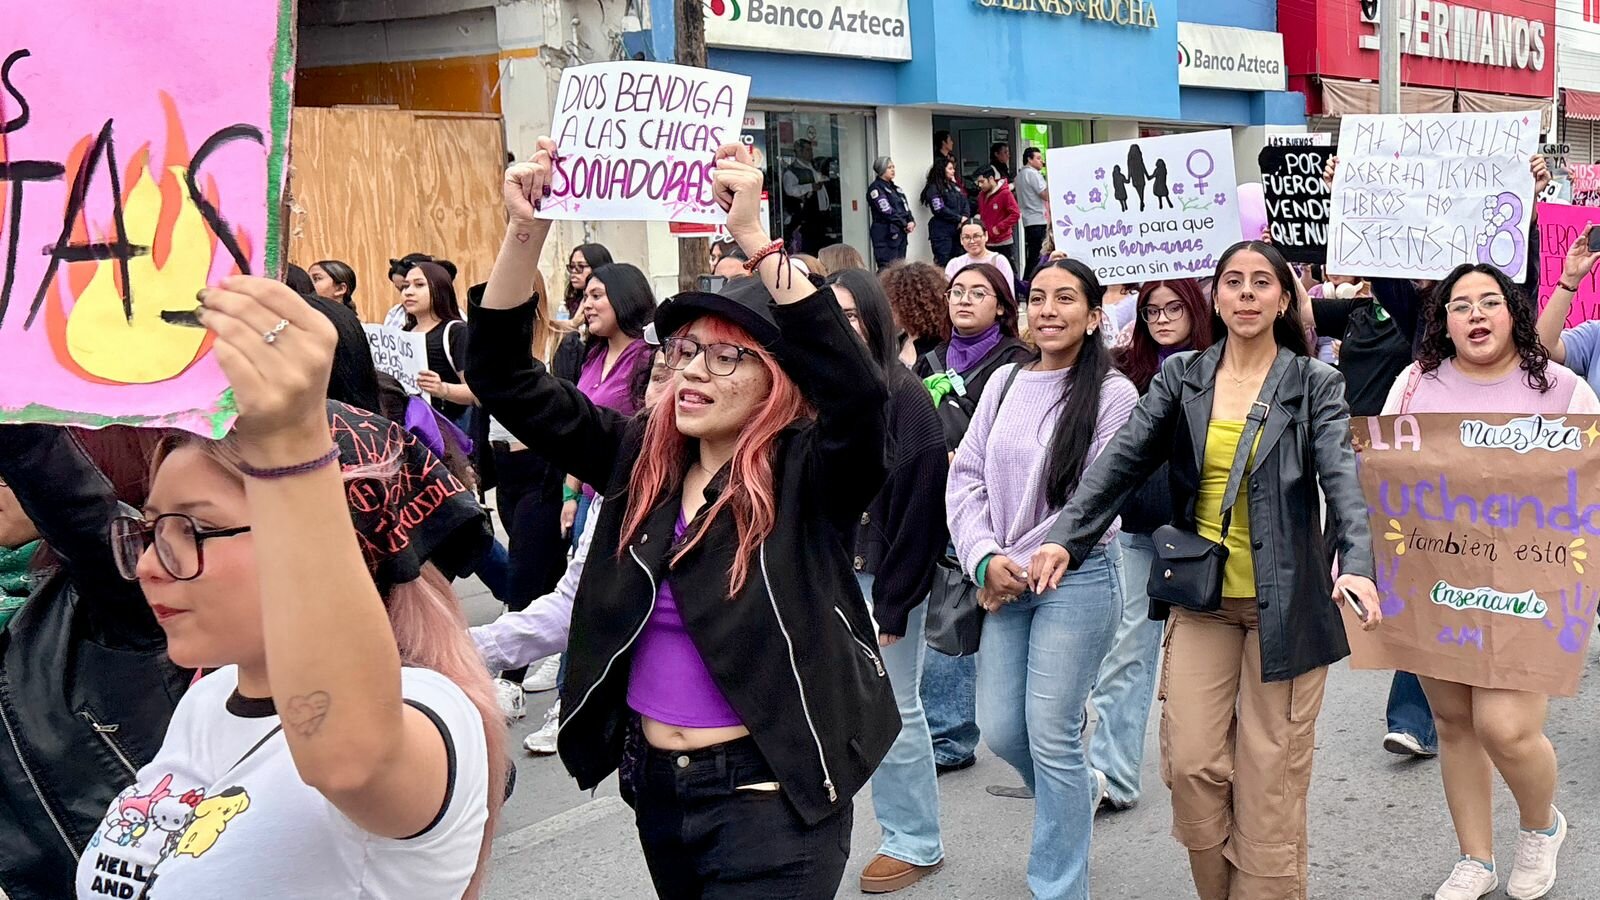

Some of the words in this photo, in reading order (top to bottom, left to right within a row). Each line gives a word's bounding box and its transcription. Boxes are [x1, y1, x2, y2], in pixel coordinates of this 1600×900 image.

[747, 0, 823, 30] Banco
[828, 6, 905, 37] Azteca
[1088, 0, 1160, 28] ROCHA
[1194, 49, 1235, 71] Banco
[1237, 53, 1279, 74] Azteca
[562, 73, 608, 113] DIOS
[615, 72, 734, 119] BENDIGA
[558, 115, 579, 148] A
[585, 116, 627, 149] LAS
[639, 119, 725, 154] CHICAS
[1400, 119, 1521, 157] MOCHILA
[1543, 144, 1570, 154] GRITO
[1285, 152, 1323, 175] POR
[553, 154, 716, 207] SOÑADORAS
[1342, 191, 1407, 216] LIBROS
[1139, 221, 1178, 237] para
[1182, 216, 1214, 233] que
[1092, 245, 1117, 258] mis
[1119, 238, 1204, 257] hermanas
[1340, 222, 1469, 266] DEFENSA
[1093, 264, 1146, 279] rezcan
[1149, 260, 1169, 274] sin
[1368, 414, 1421, 451] LA
[1366, 467, 1600, 536] uchando
[95, 852, 158, 884] HELL
[91, 875, 134, 899] AND
